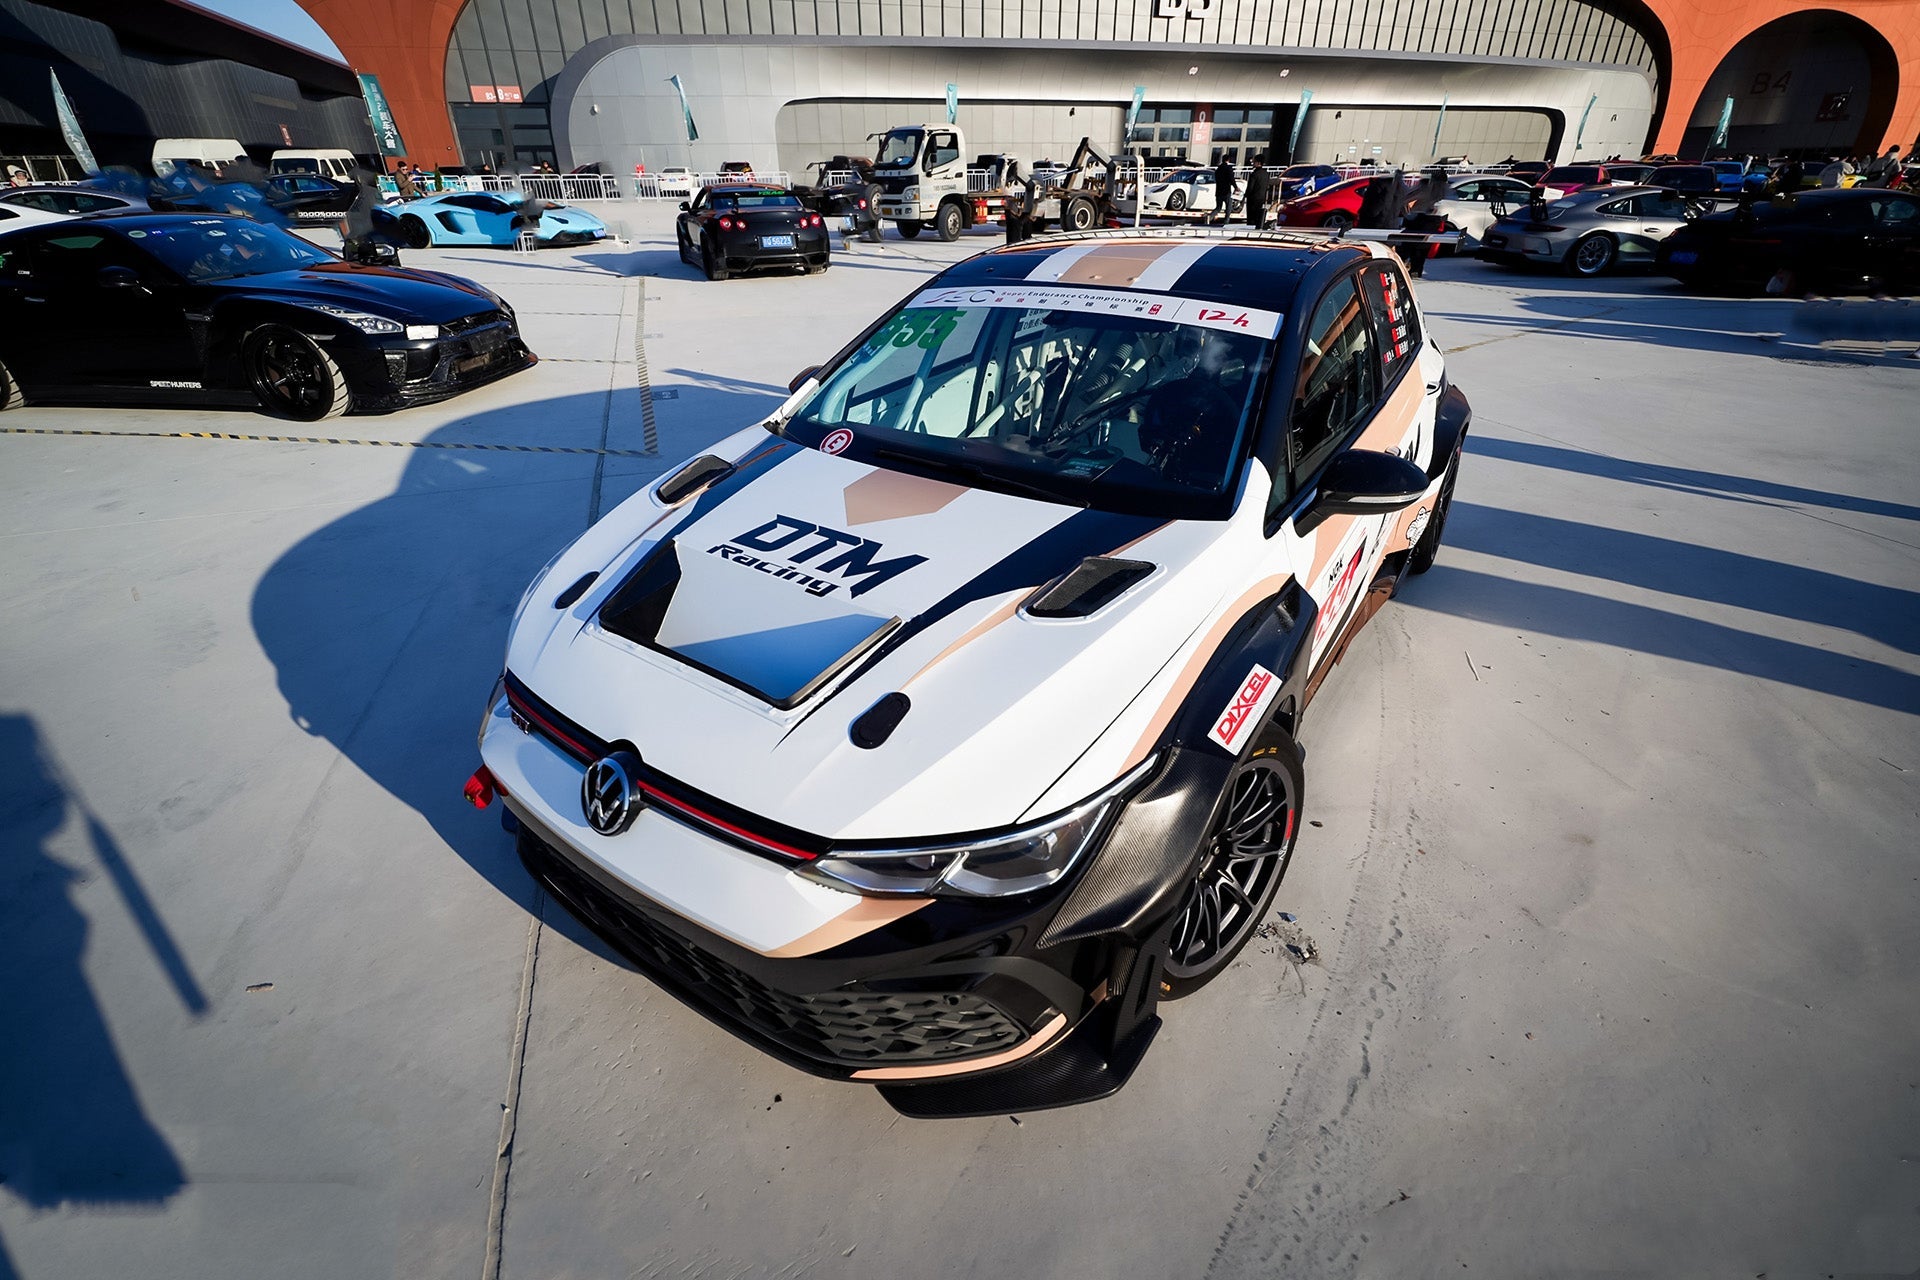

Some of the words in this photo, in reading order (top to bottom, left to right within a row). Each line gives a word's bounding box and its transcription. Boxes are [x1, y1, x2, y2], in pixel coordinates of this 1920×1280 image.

[1749, 70, 1793, 95] B4
[1028, 291, 1077, 299] Endurance
[1078, 293, 1149, 305] Championship
[706, 544, 841, 598] Racing
[729, 514, 930, 599] DTM
[1216, 672, 1268, 741] DIXCEL
